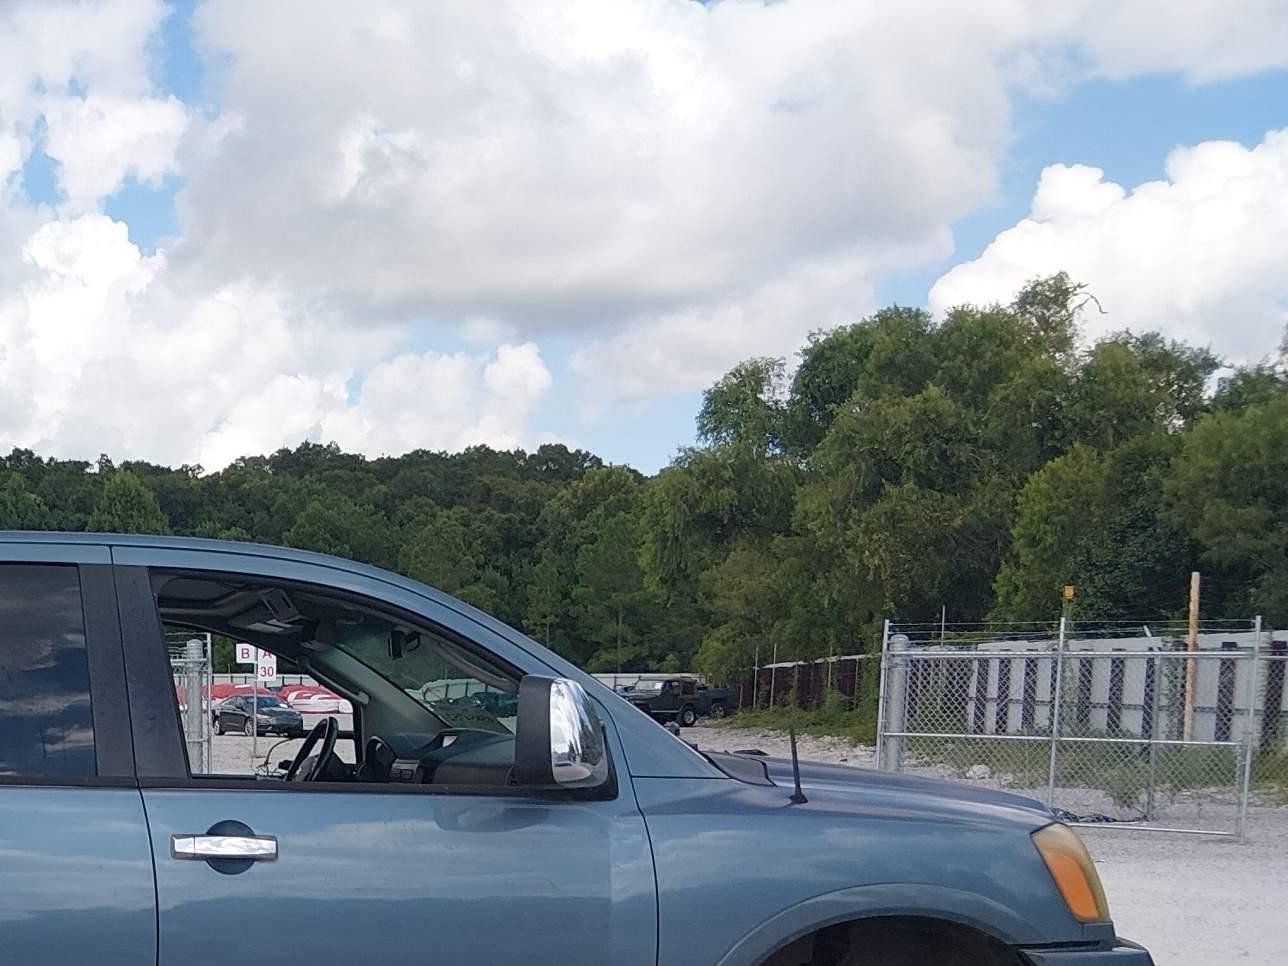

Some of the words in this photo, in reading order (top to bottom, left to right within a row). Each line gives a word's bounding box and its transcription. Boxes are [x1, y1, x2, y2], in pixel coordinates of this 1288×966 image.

[241, 648, 250, 659] B
[262, 650, 273, 659] A
[260, 666, 274, 677] 30
